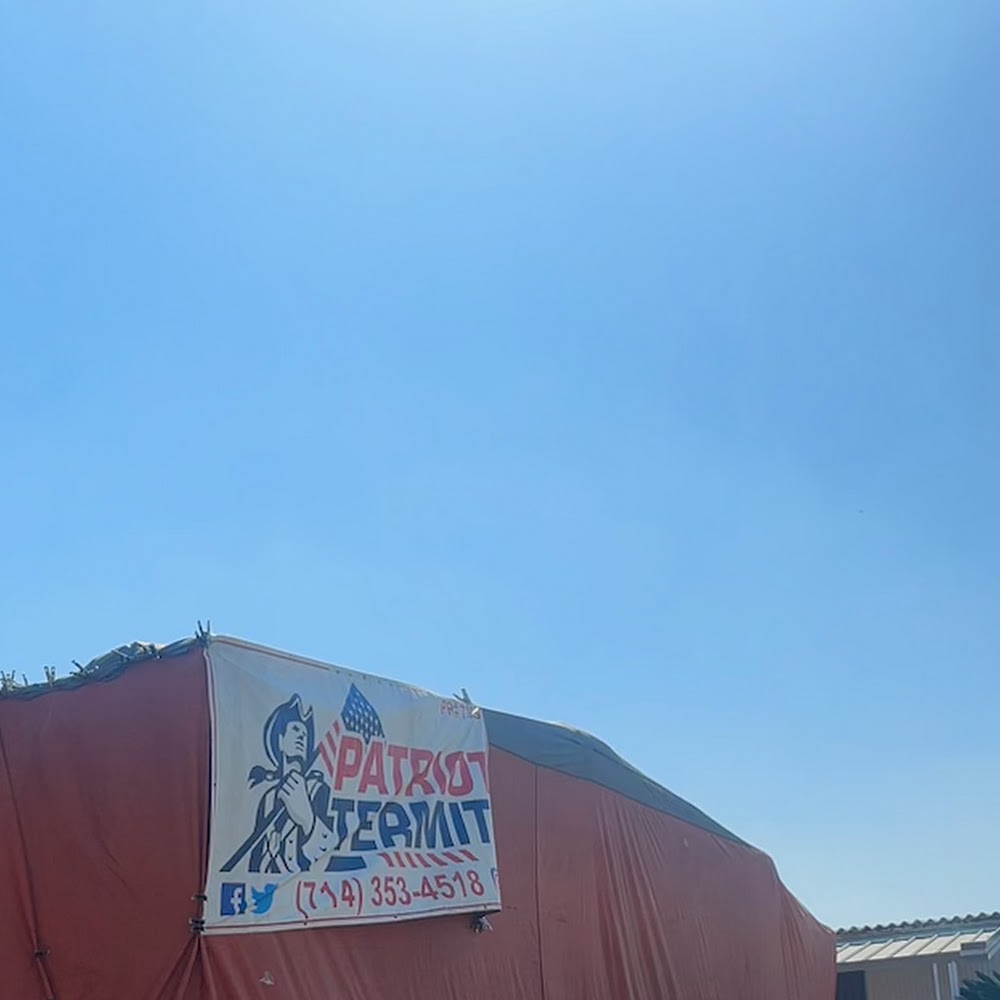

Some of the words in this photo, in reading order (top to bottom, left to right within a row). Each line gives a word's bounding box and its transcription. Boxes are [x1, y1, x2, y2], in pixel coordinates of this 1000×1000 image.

[334, 735, 489, 797] PATRIOT
[331, 798, 490, 851] TERMIT
[296, 877, 363, 918] (714)
[371, 870, 485, 906] 353-4518
